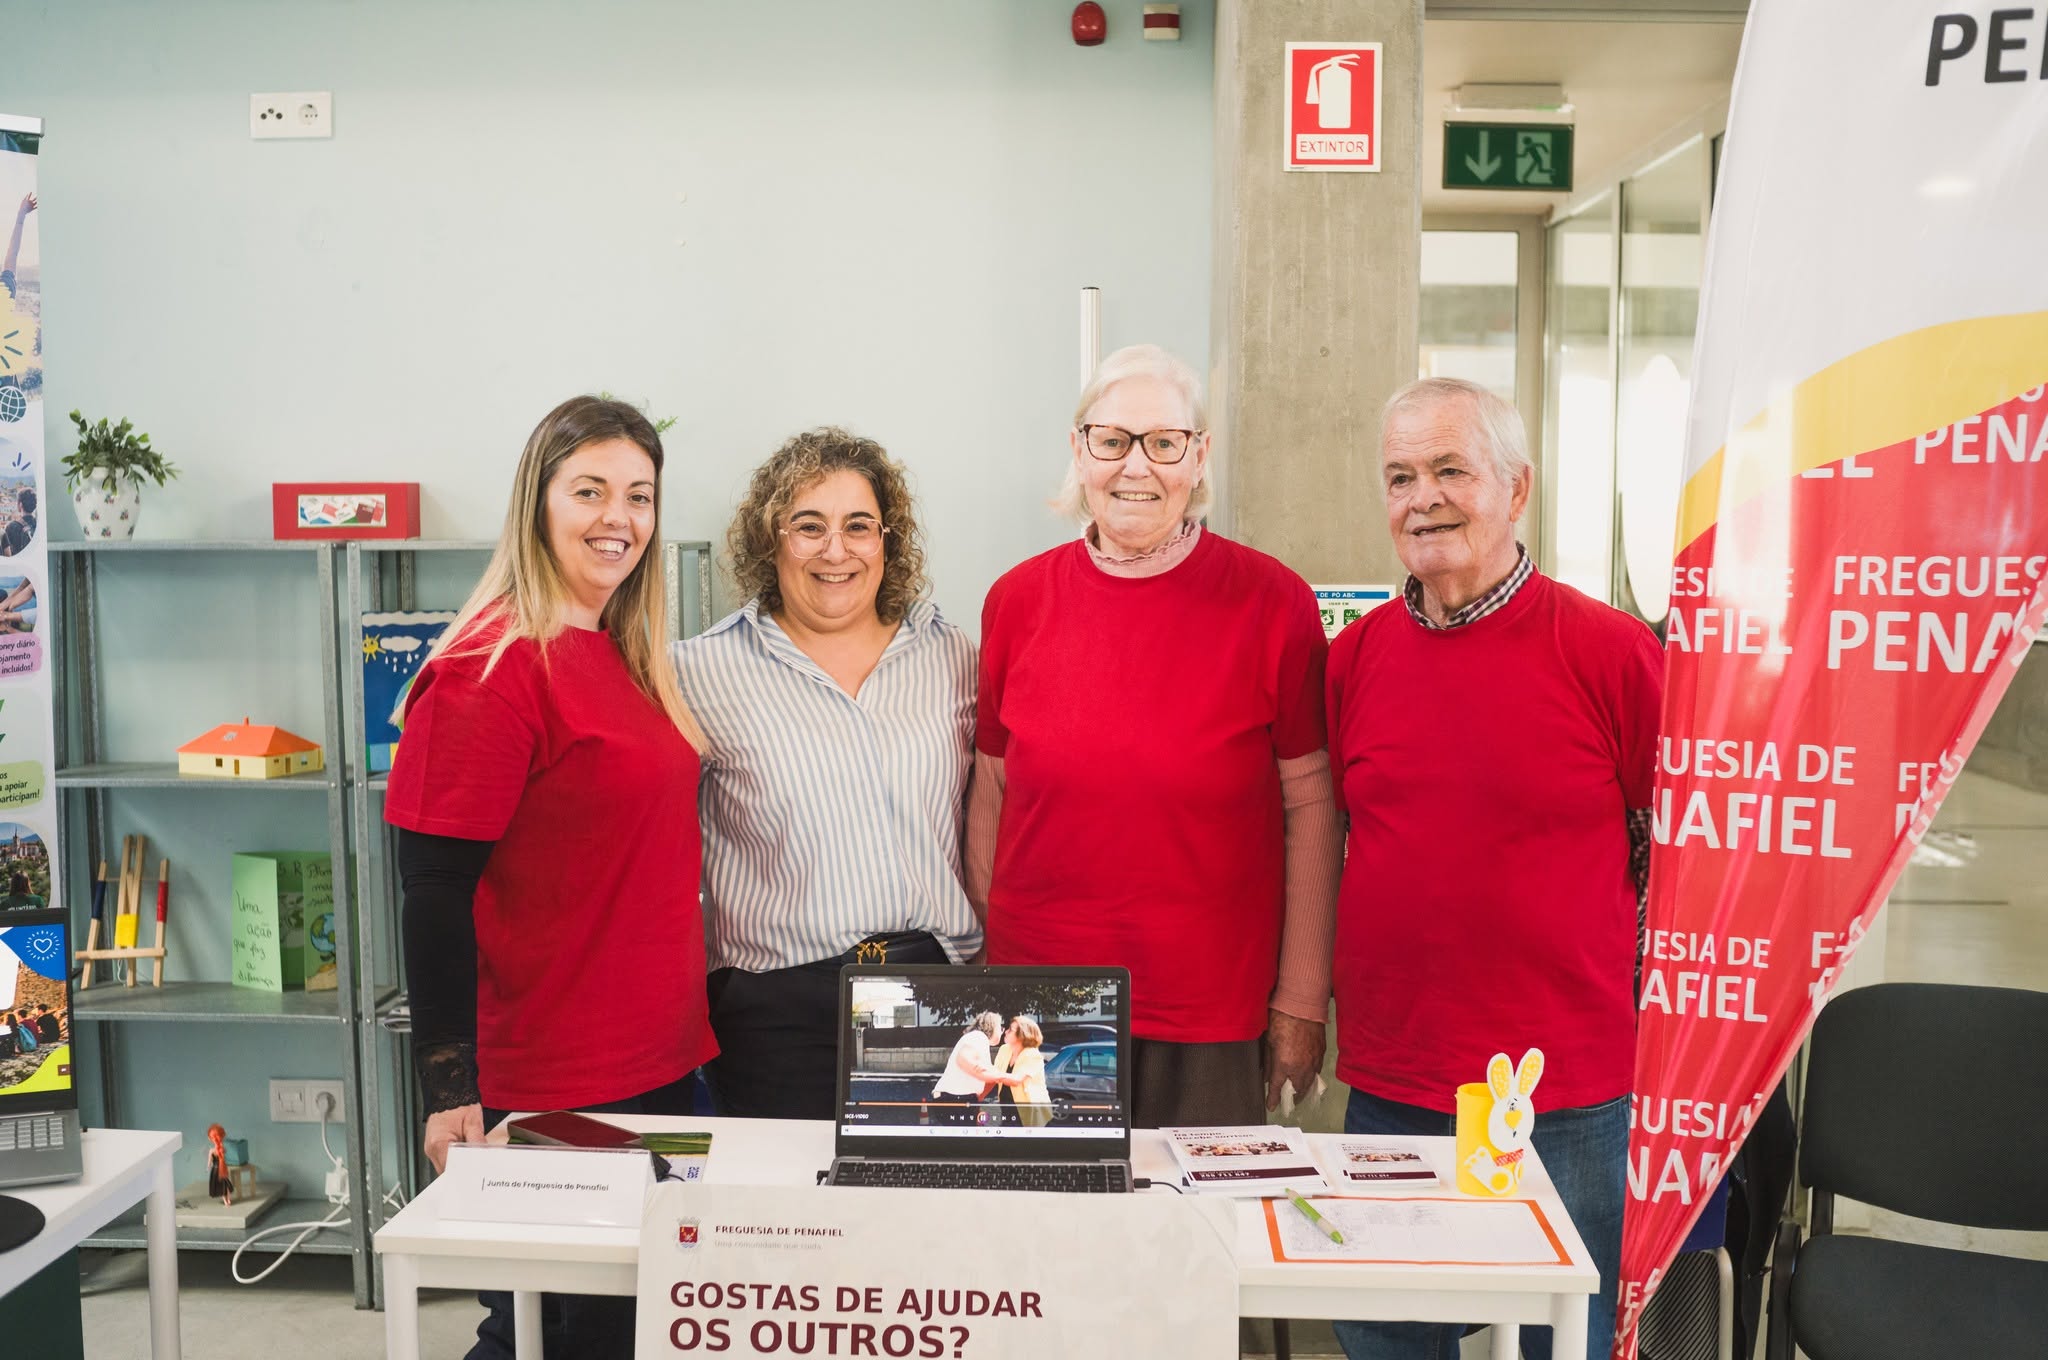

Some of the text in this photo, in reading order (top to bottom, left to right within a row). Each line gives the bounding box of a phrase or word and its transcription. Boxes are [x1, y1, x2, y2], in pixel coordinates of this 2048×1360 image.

[1300, 141, 1364, 153] EXTINTOR
[1655, 736, 1857, 785] UESIA DE
[1727, 936, 1771, 969] DE
[1639, 968, 1768, 1023] AFIEL
[523, 1181, 562, 1190] Freguesia
[576, 1183, 609, 1191] Penafiel
[715, 1225, 844, 1237] FREGUESIA DE PENAFIEL
[670, 1281, 1043, 1321] GOSTAS DE AJUDAR
[669, 1317, 970, 1359] OS OUTROS?
